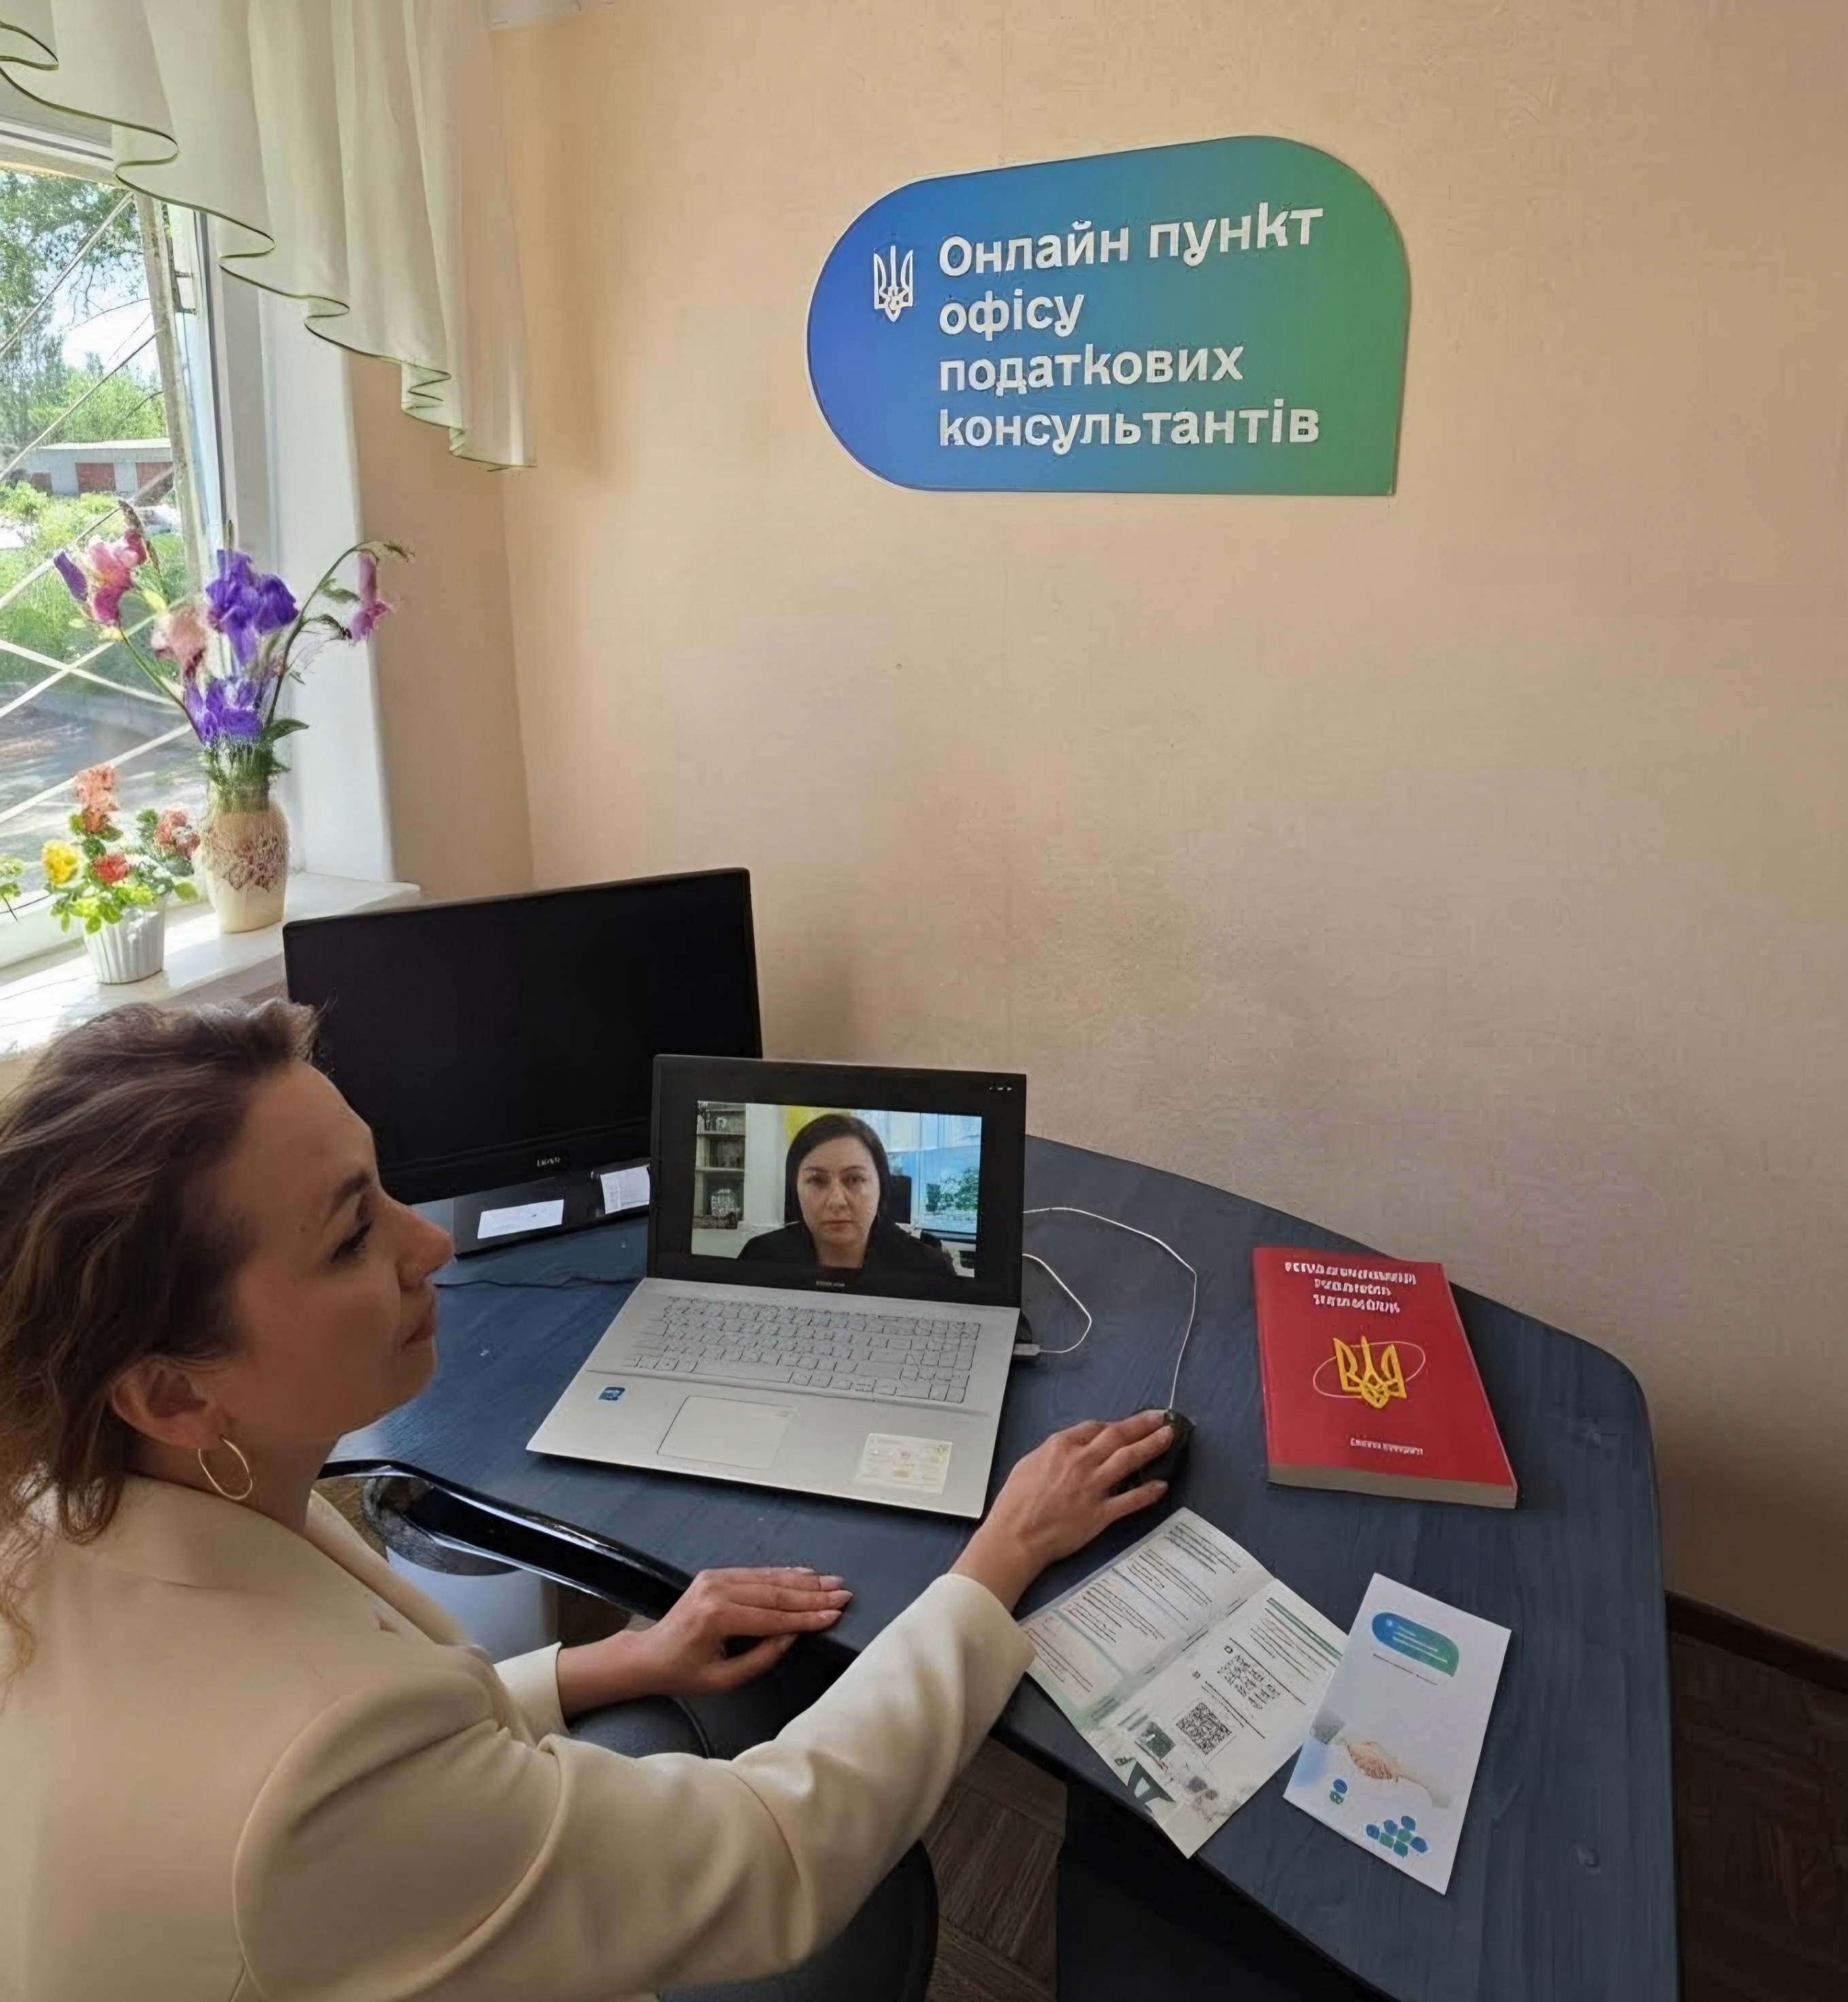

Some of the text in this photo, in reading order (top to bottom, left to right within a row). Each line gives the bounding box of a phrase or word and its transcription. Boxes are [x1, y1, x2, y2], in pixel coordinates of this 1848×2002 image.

[939, 201, 1324, 277] Онлайн пункт
[939, 288, 1085, 342] офісу
[940, 343, 1244, 397] податкових
[940, 398, 1320, 456] консультантів
